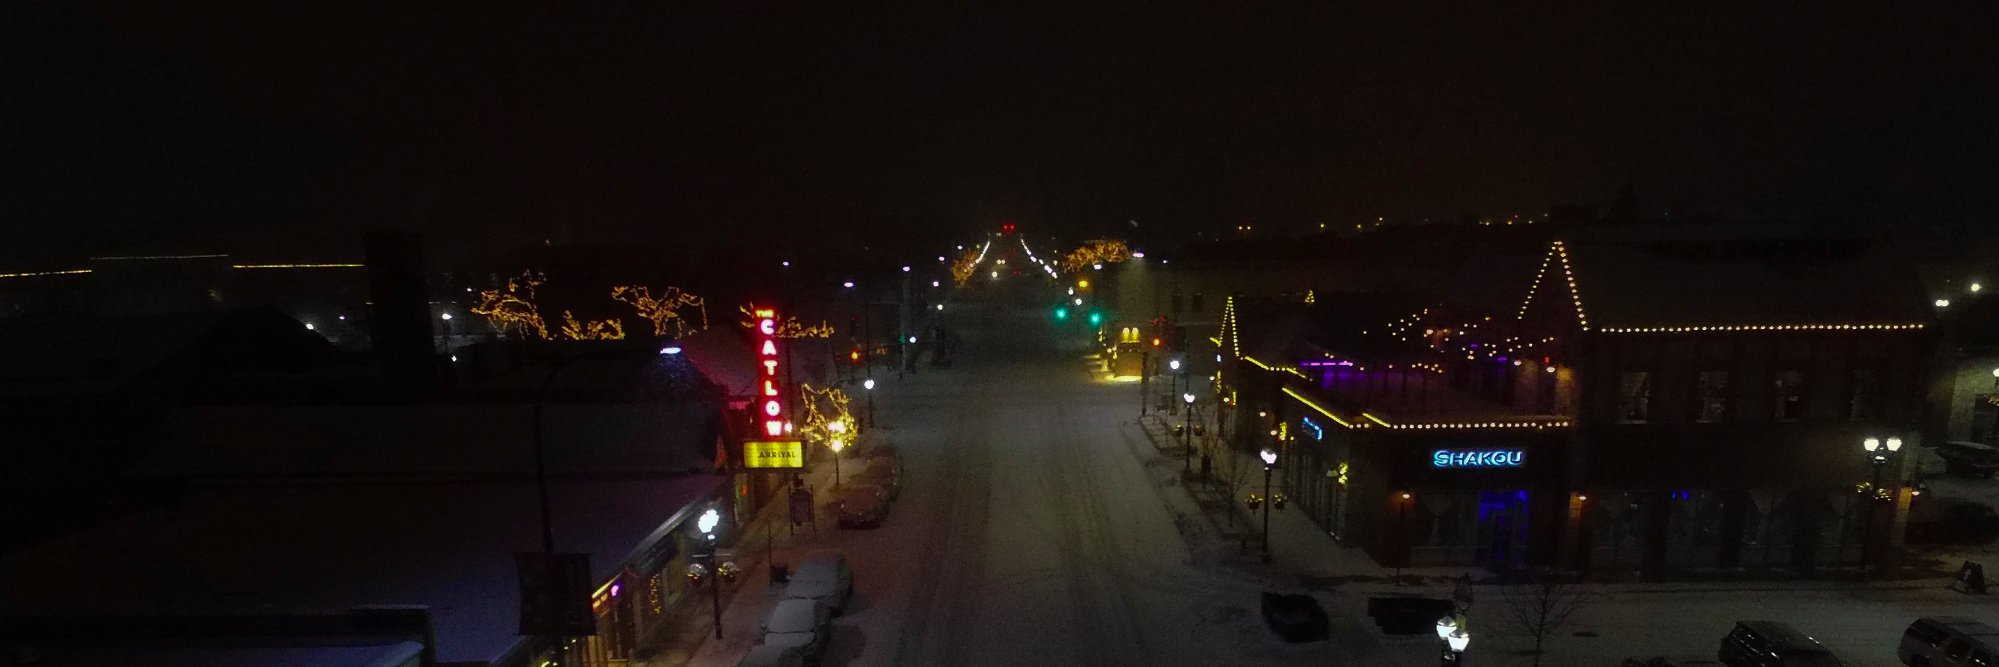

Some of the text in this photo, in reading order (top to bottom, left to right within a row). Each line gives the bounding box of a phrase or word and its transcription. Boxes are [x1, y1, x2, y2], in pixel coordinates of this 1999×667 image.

[760, 319, 782, 436] CATLOW
[758, 450, 796, 459] ARRIVAL
[1433, 450, 1524, 467] SHAKOU
